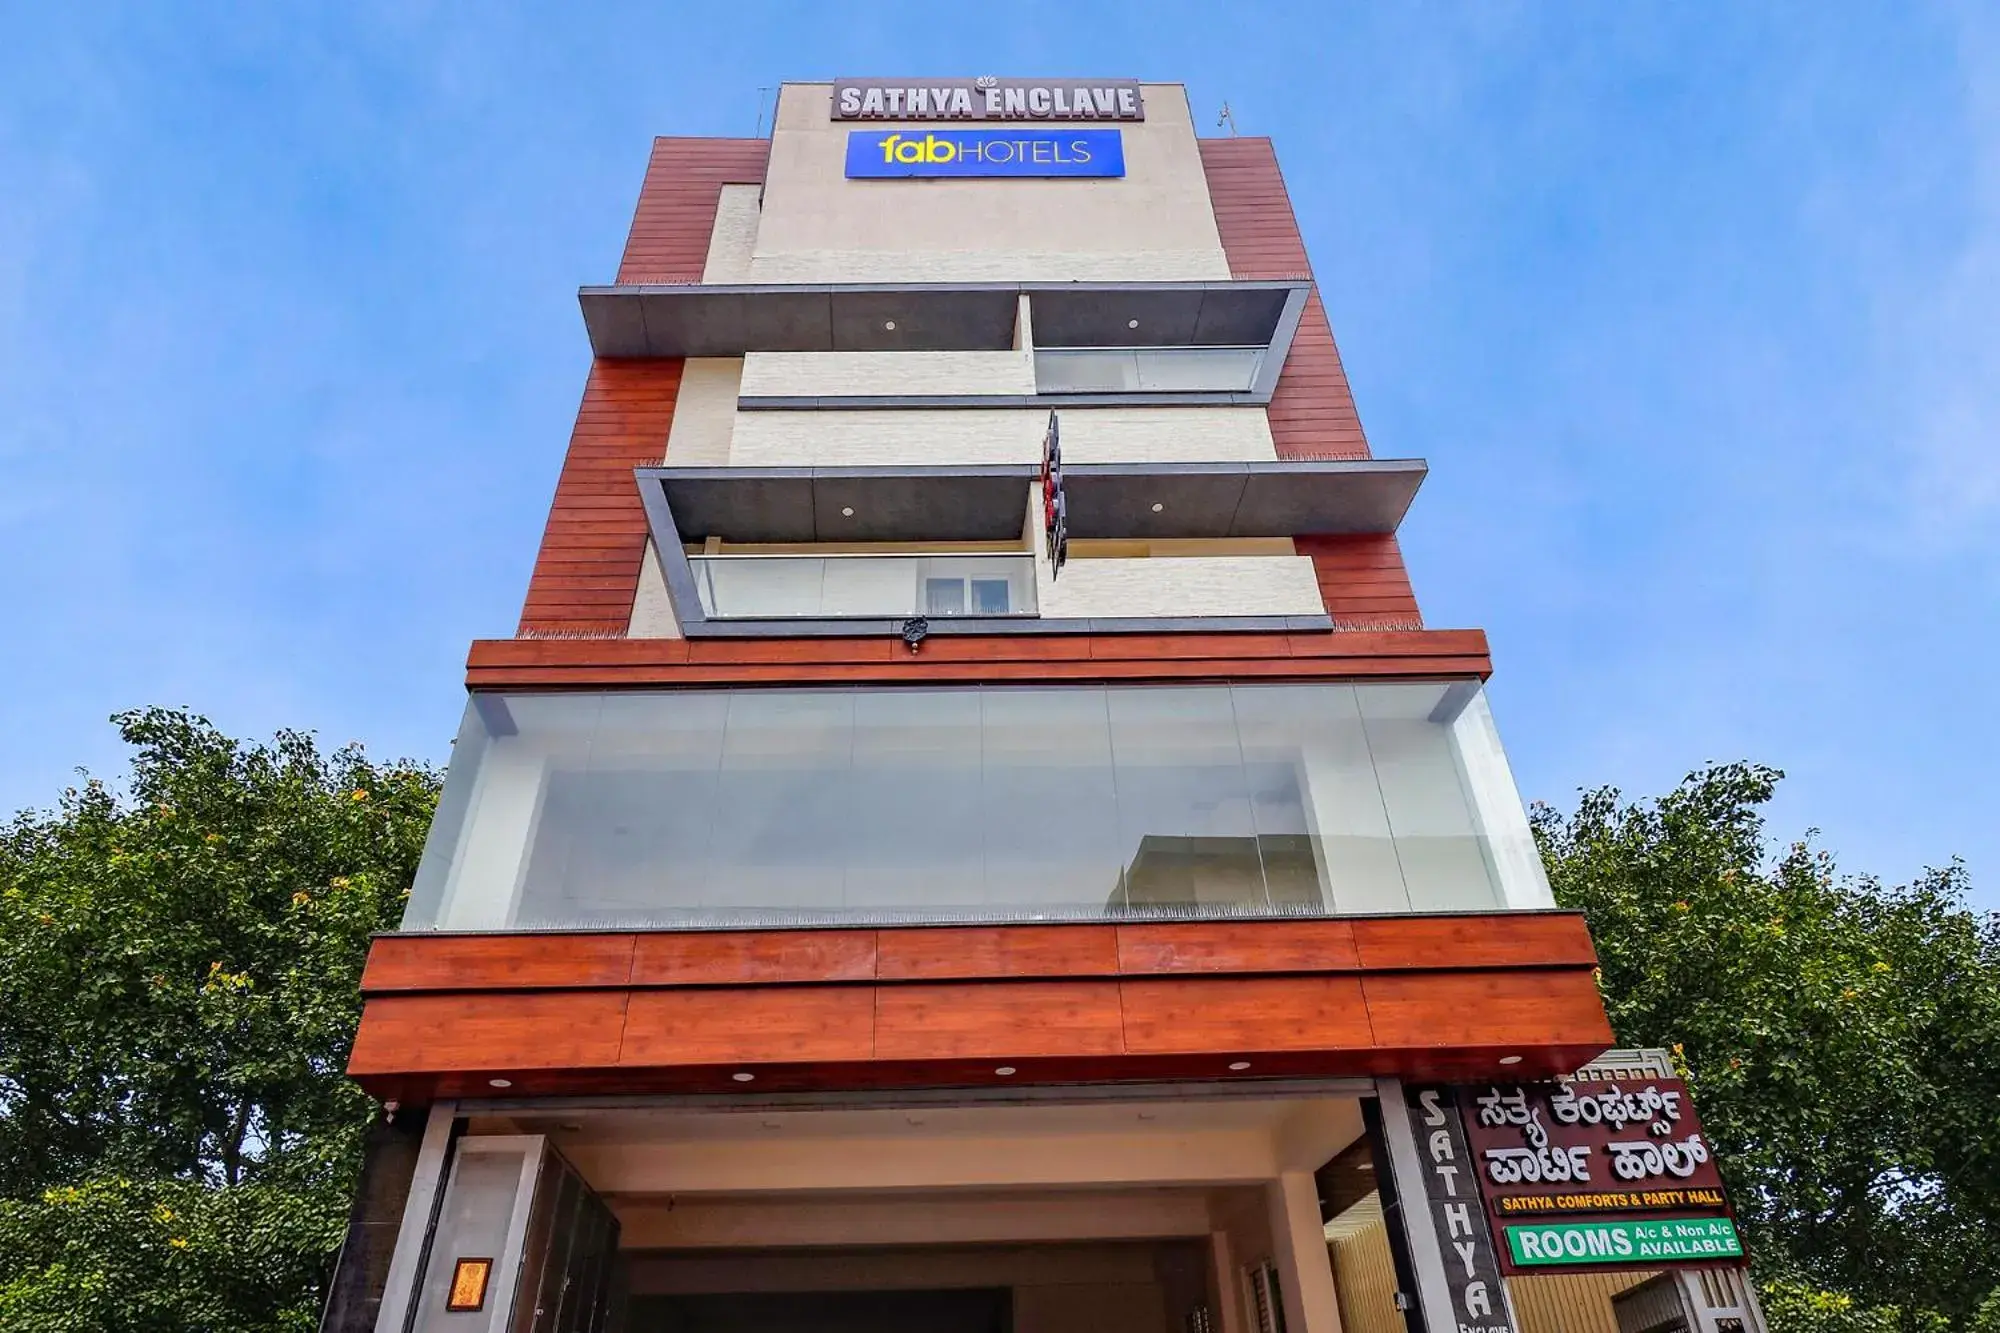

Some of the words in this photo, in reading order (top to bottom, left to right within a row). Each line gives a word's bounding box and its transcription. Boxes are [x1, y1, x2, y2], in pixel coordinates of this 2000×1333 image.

[840, 87, 972, 115] SATHYA
[985, 87, 1138, 115] ENCLAVE
[1477, 1087, 1548, 1148] ಸತ್ಯ
[1608, 1134, 1708, 1179] ಹಾಲ್
[1418, 1090, 1492, 1320] SATHYA
[1503, 1196, 1554, 1210] SATHYA
[1557, 1193, 1629, 1209] COMFORTS
[1631, 1193, 1638, 1205] &
[1645, 1191, 1684, 1205] PARTY
[1687, 1189, 1723, 1203] HALL
[1519, 1229, 1633, 1259] ROOMS
[1662, 1226, 1673, 1237] &
[1676, 1224, 1705, 1237] Non
[1640, 1239, 1739, 1256] AVAILABLE
